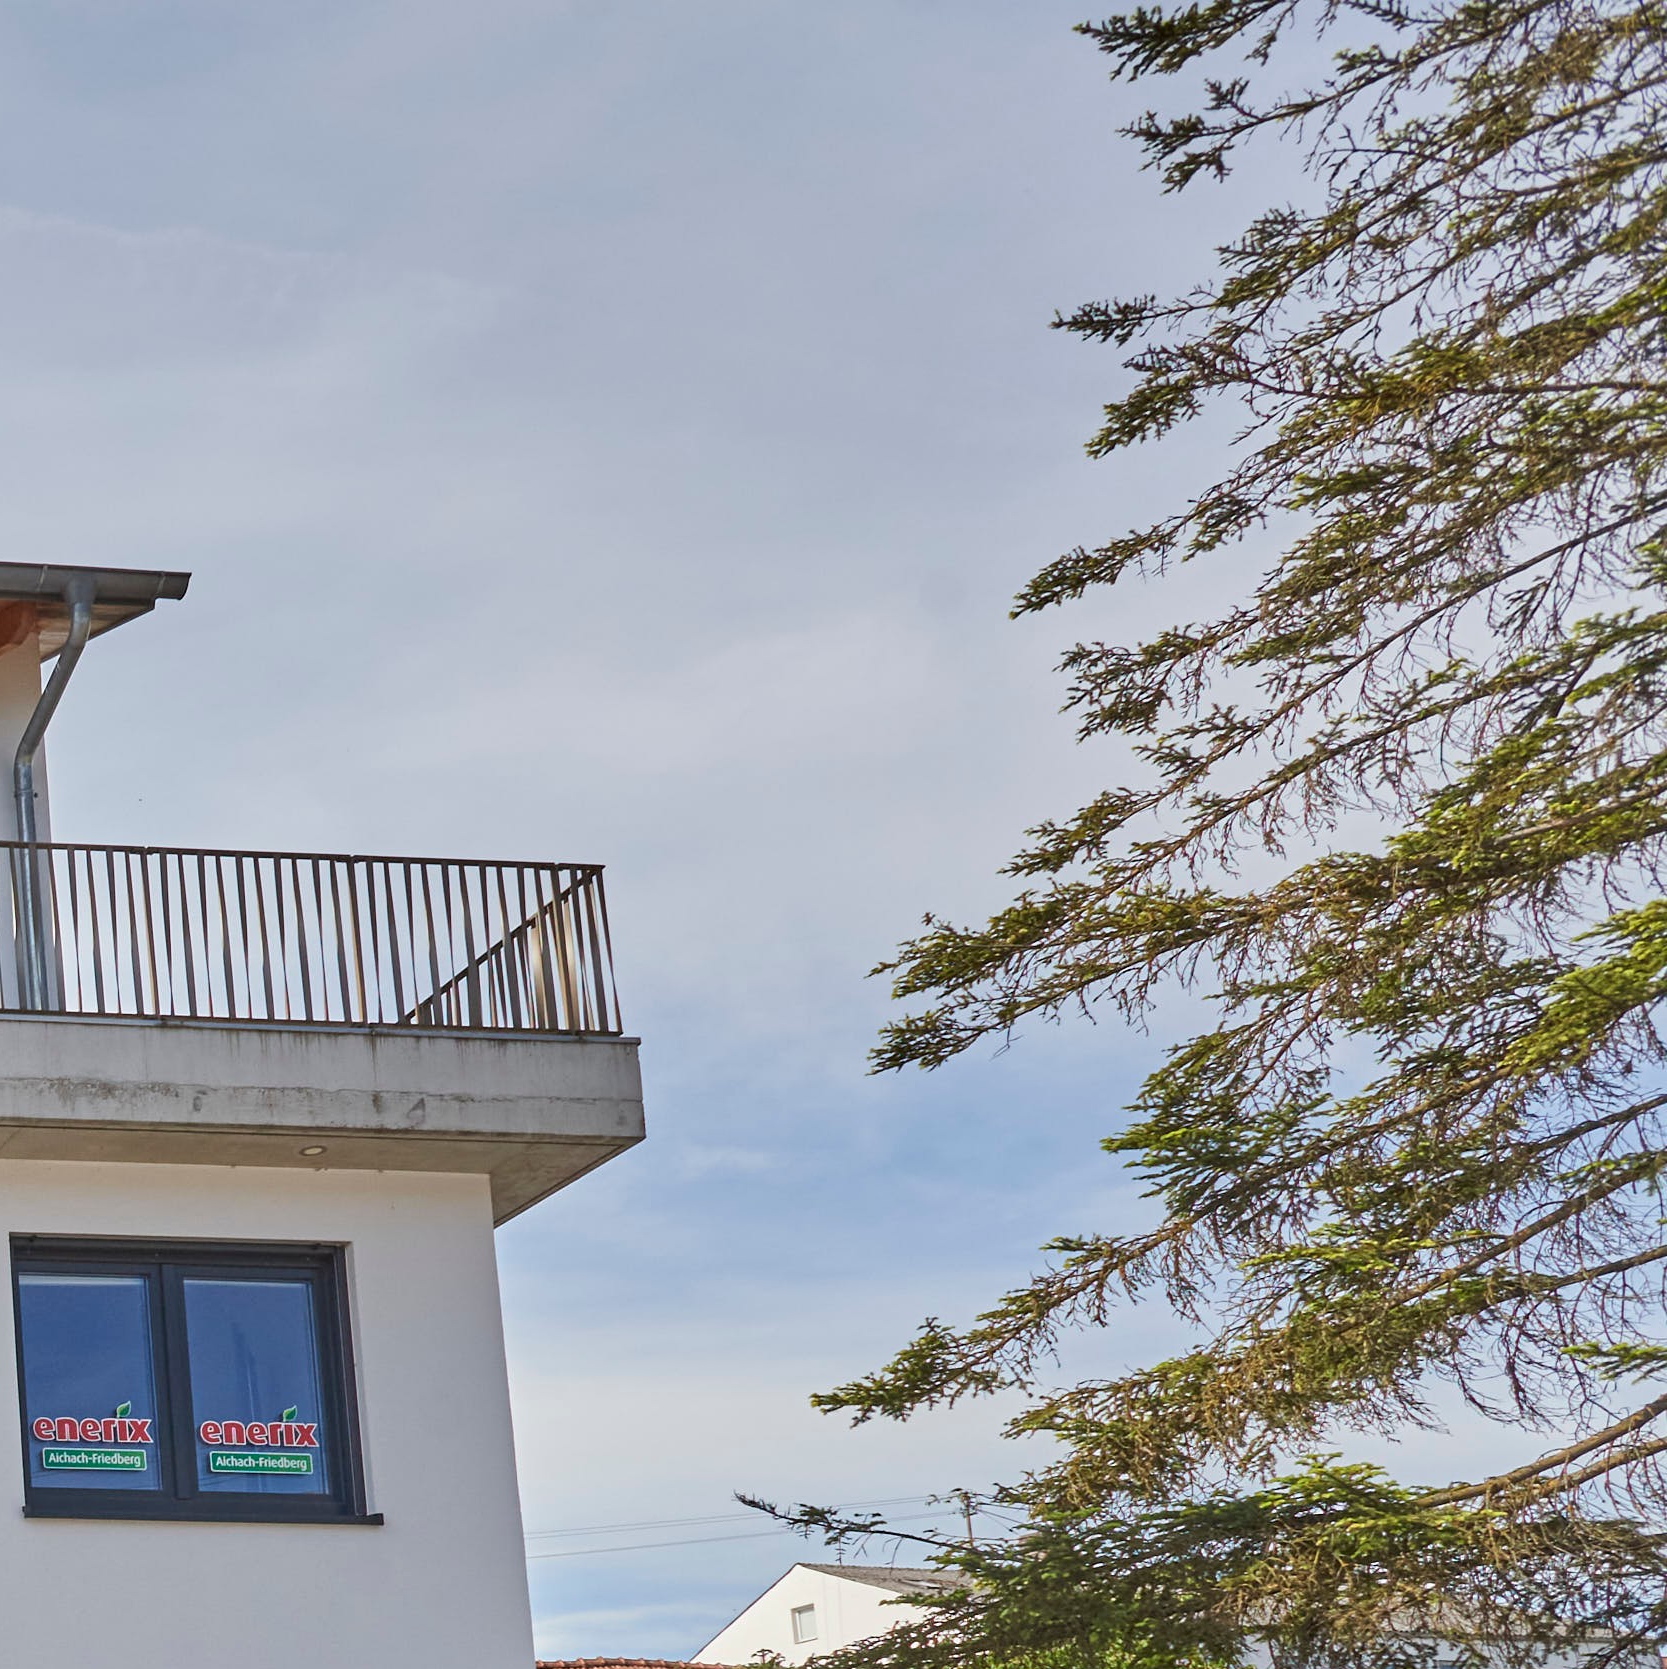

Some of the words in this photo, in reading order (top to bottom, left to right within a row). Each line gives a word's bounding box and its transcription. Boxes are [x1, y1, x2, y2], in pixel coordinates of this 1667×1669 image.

[33, 1400, 153, 1443] enerix
[200, 1405, 319, 1447] enerix
[48, 1452, 142, 1467] Aichach-Friedberg
[216, 1455, 308, 1471] Aichach-Friedberg
